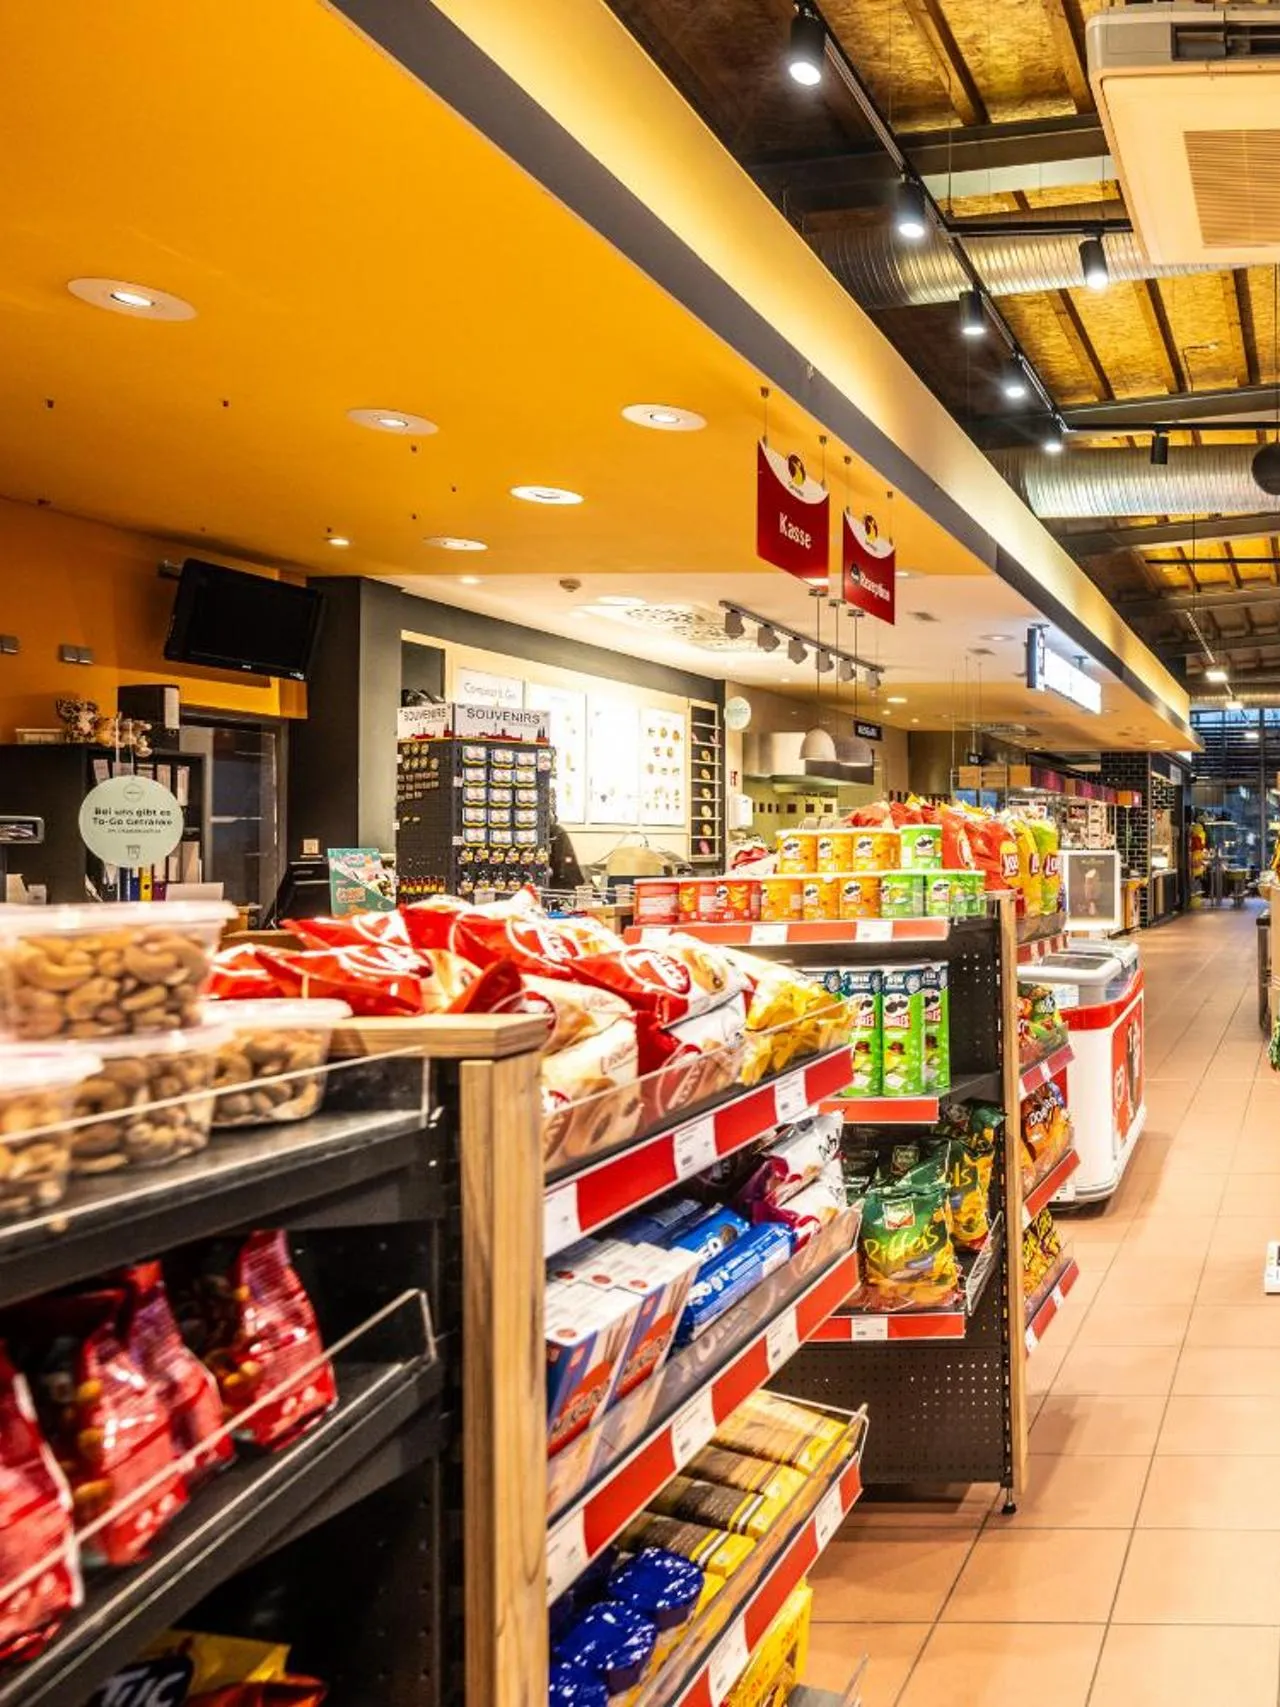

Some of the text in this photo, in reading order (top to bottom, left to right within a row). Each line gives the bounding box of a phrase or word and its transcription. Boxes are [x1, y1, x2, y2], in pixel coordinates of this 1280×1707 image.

[778, 512, 812, 549] Kasse
[466, 708, 541, 725] SOUVENIRS
[136, 807, 157, 818] gibt
